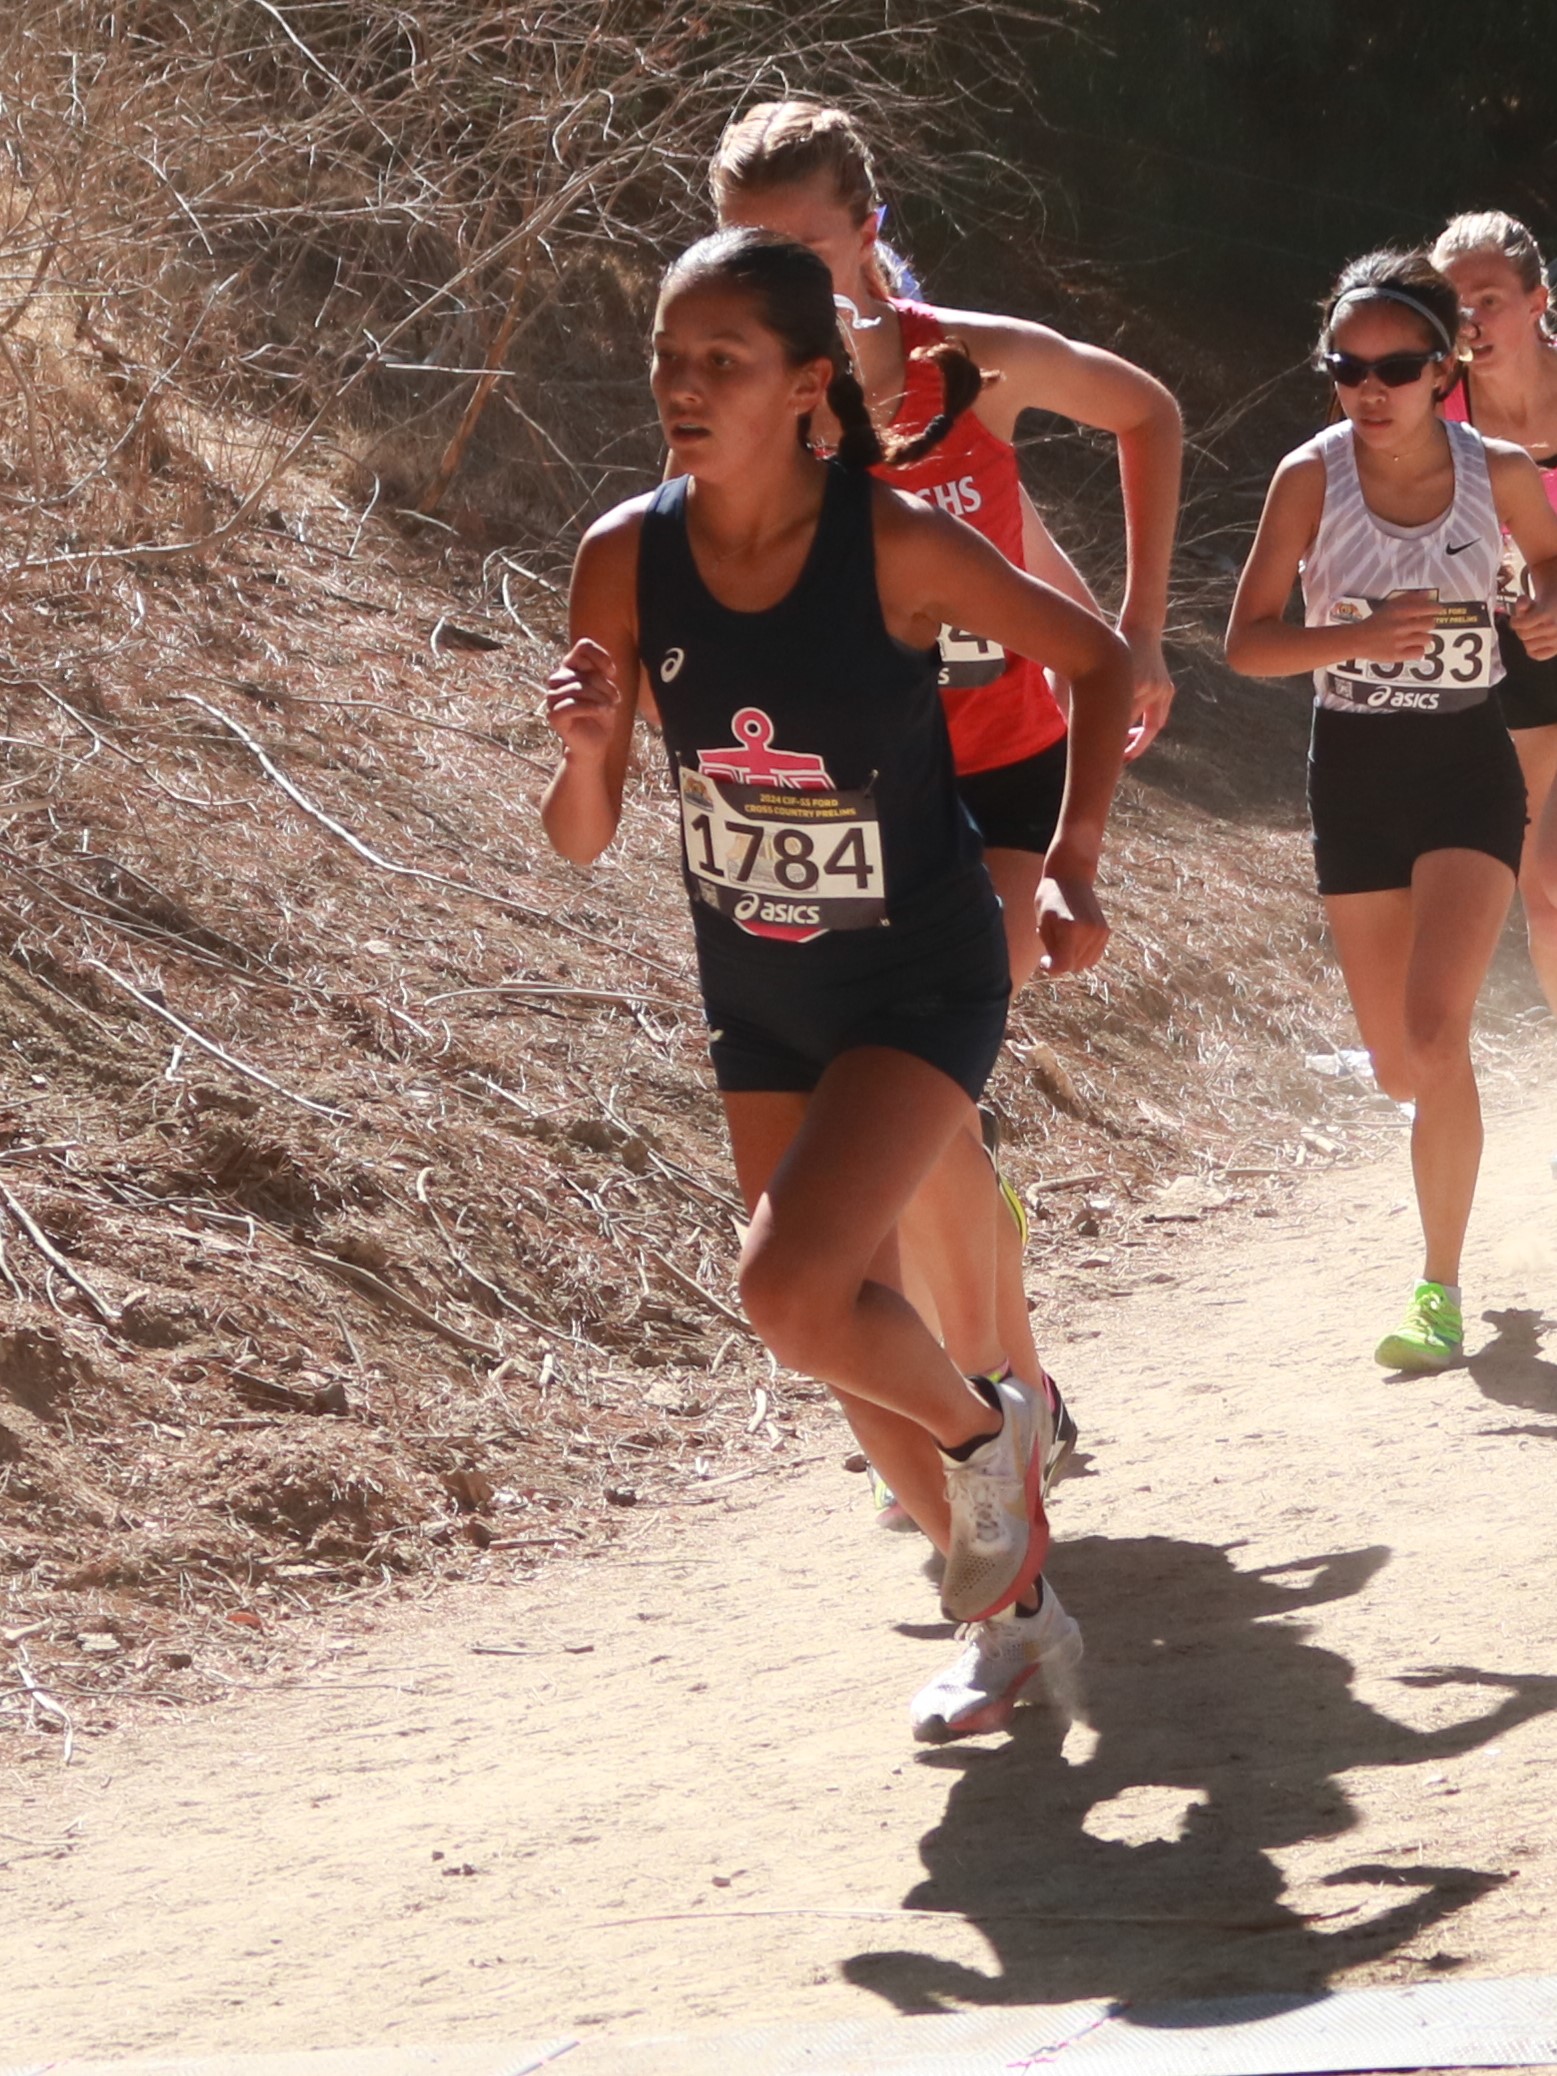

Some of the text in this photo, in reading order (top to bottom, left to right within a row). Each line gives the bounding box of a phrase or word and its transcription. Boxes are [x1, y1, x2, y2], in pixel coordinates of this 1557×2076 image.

[1337, 632, 1483, 682] 33
[744, 804, 857, 817] CROSS COUNTRY PRELIMS
[760, 793, 839, 807] 2024 CIF-SS FORD
[691, 813, 874, 891] 1784
